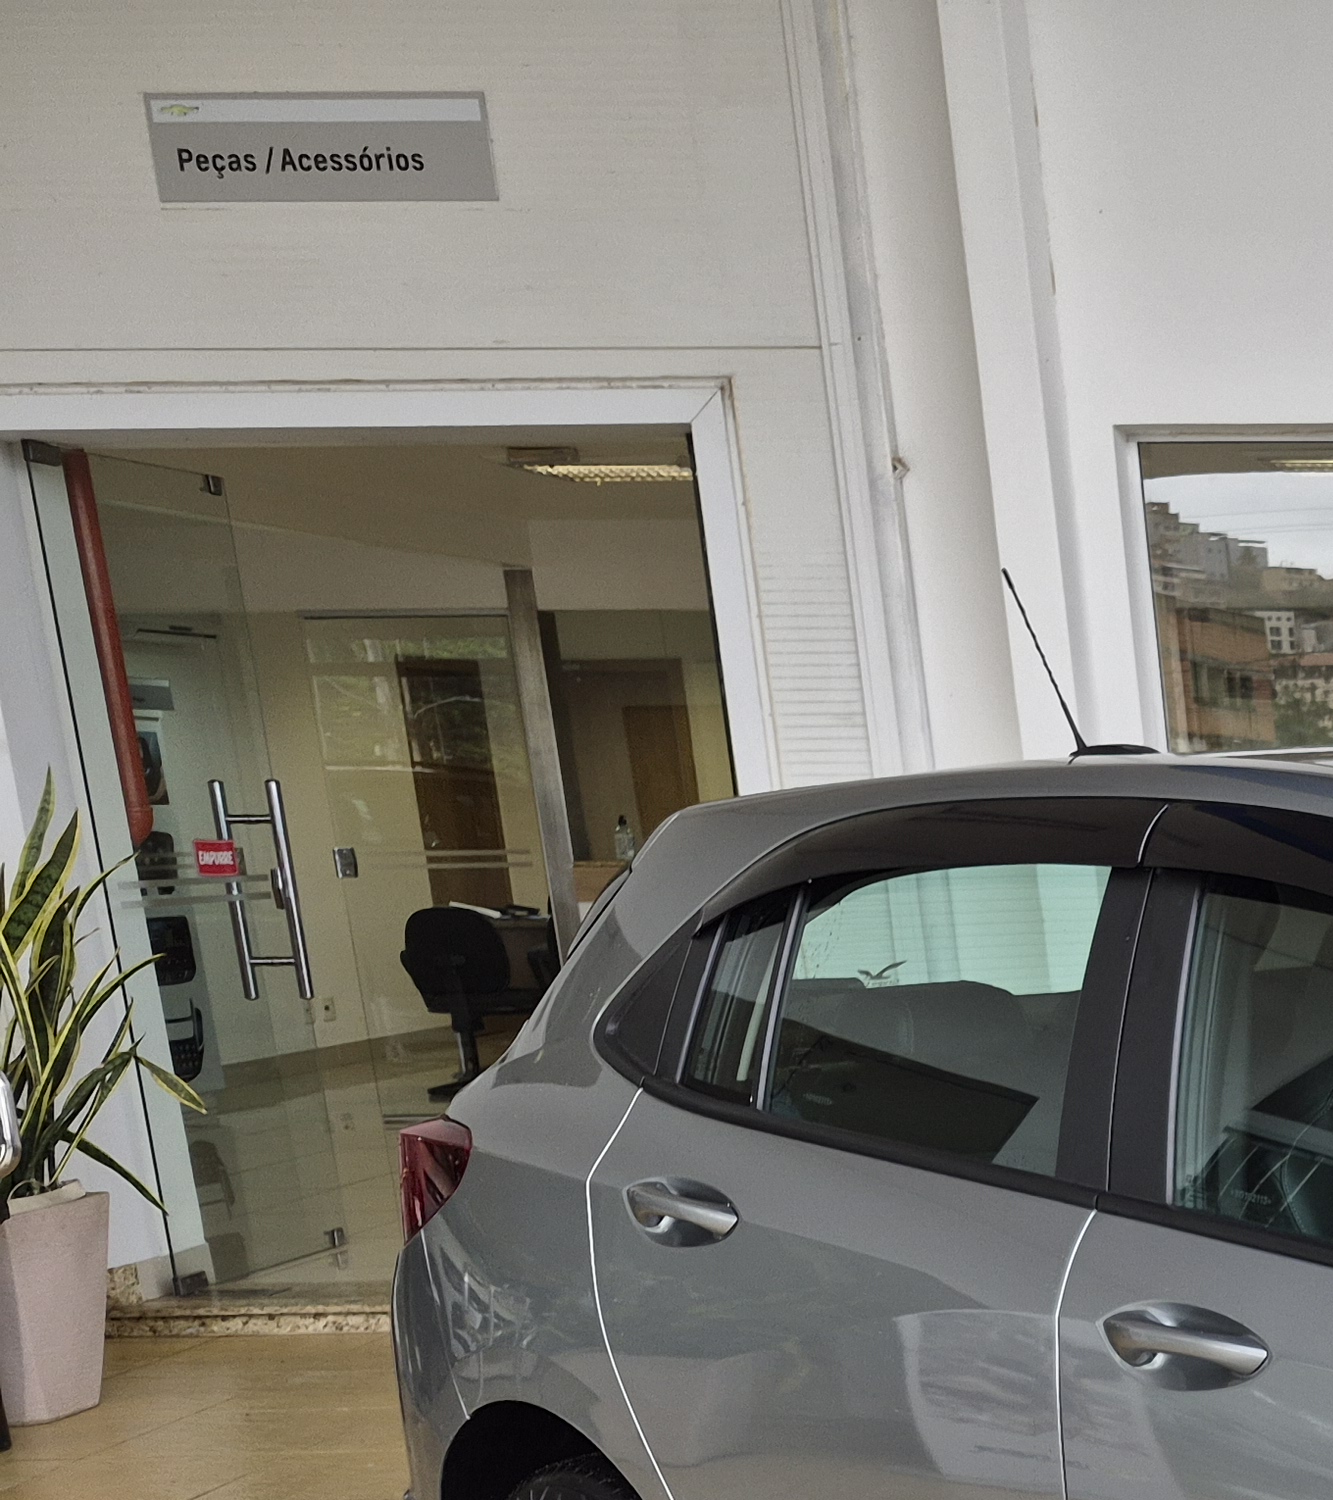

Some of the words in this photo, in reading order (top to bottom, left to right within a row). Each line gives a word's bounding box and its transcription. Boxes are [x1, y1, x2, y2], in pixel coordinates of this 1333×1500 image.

[176, 147, 257, 179] Peças
[265, 147, 274, 174] /
[280, 146, 425, 172] Acessórios
